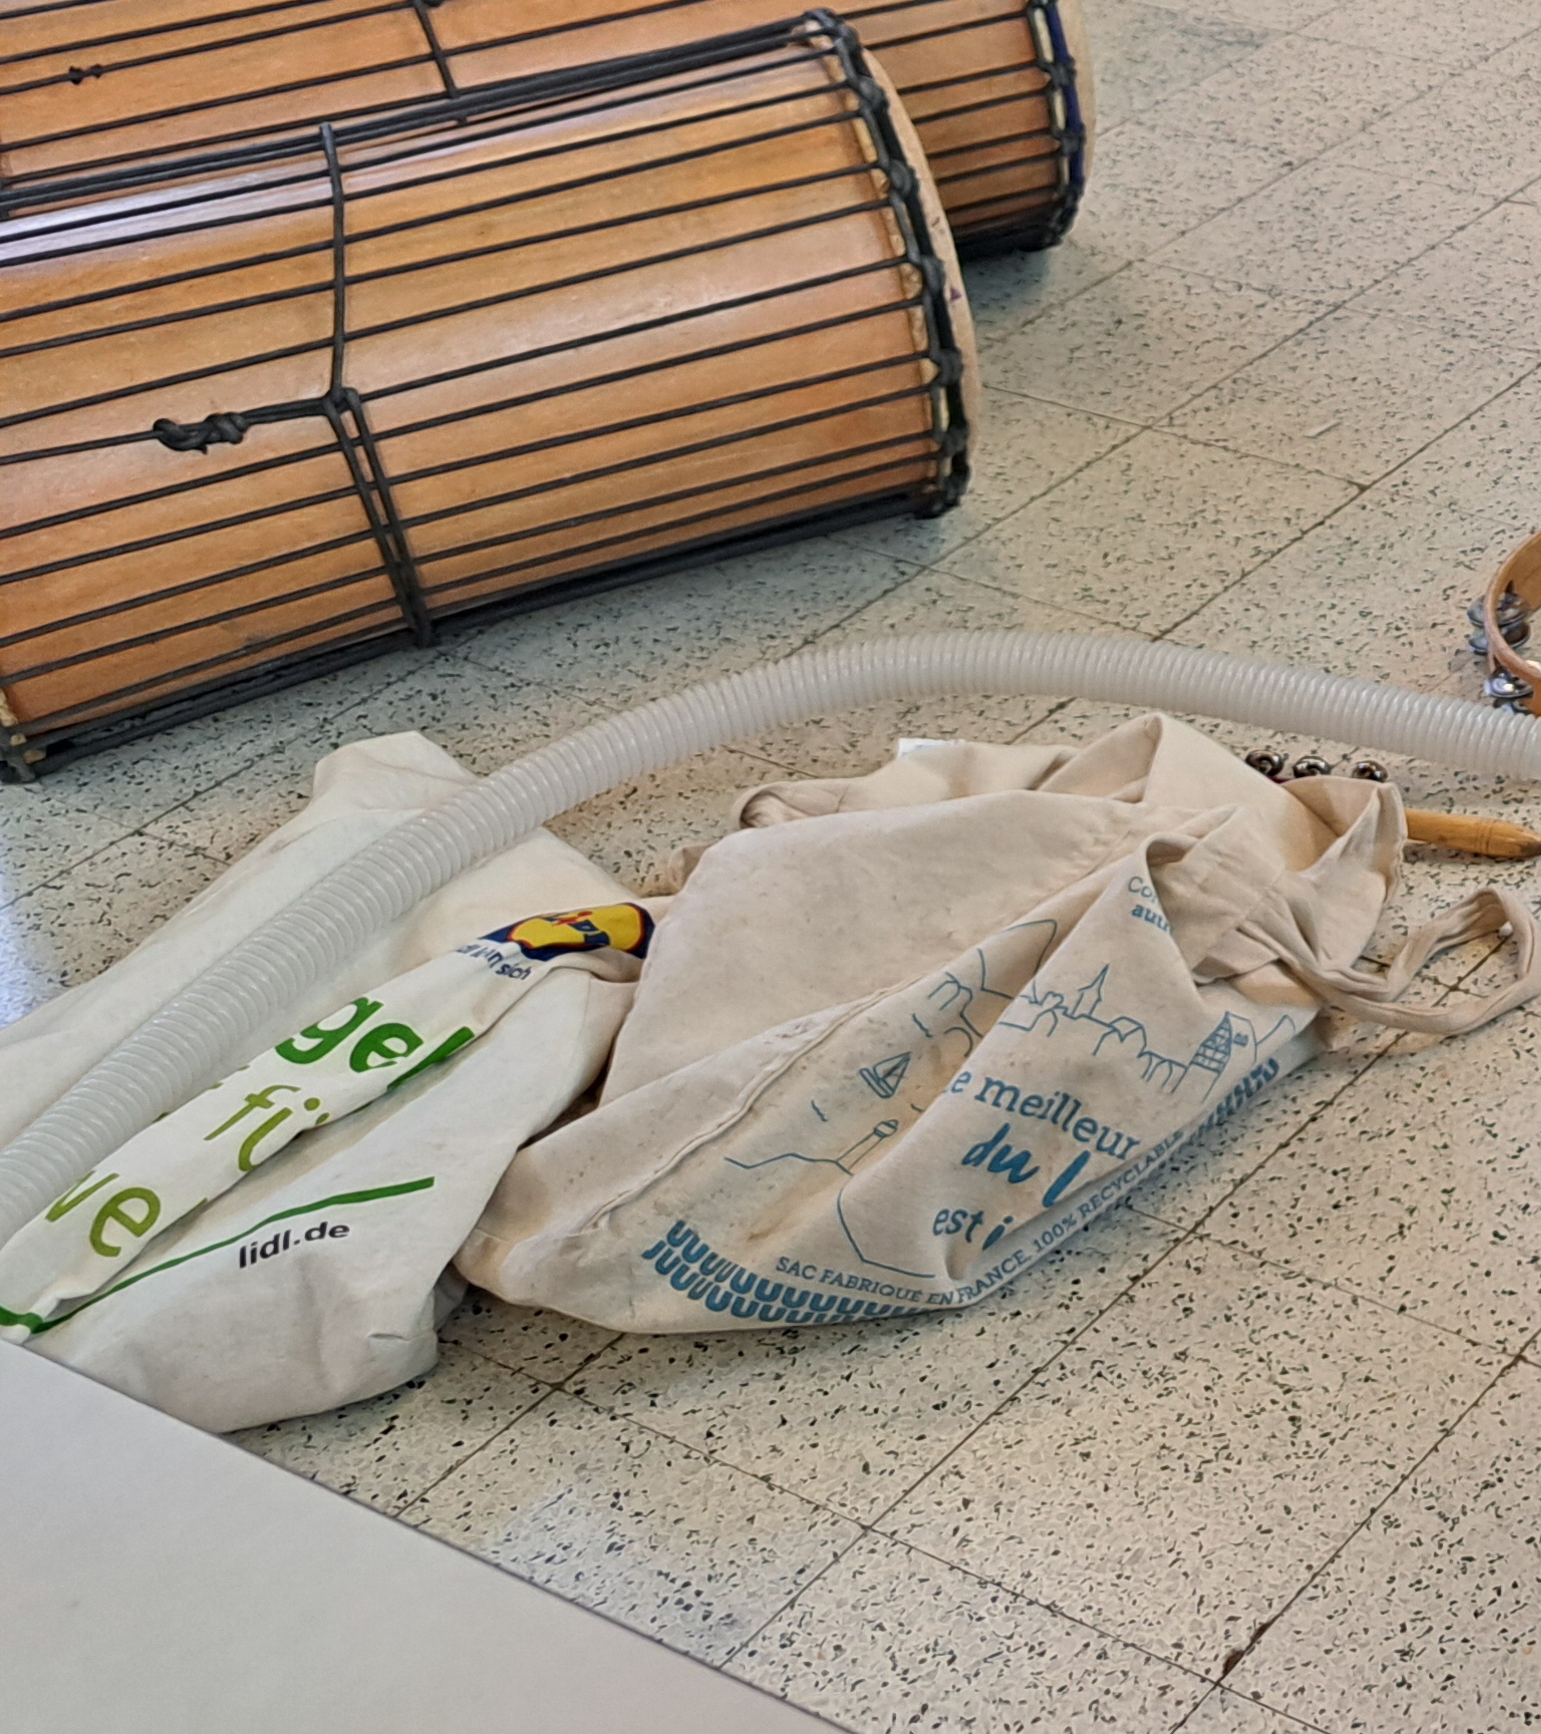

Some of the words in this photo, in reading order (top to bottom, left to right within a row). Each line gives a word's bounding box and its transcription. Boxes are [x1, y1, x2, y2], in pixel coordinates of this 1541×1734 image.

[974, 1077, 1141, 1161] meilleur
[961, 1122, 1041, 1185] du
[238, 1222, 351, 1269] lidl.de
[775, 1256, 817, 1281] SAC
[926, 1291, 954, 1305] EN
[1033, 1212, 1078, 1254] 100%
[1077, 1130, 1184, 1217] RECYCLABLE
[932, 1207, 985, 1244] est
